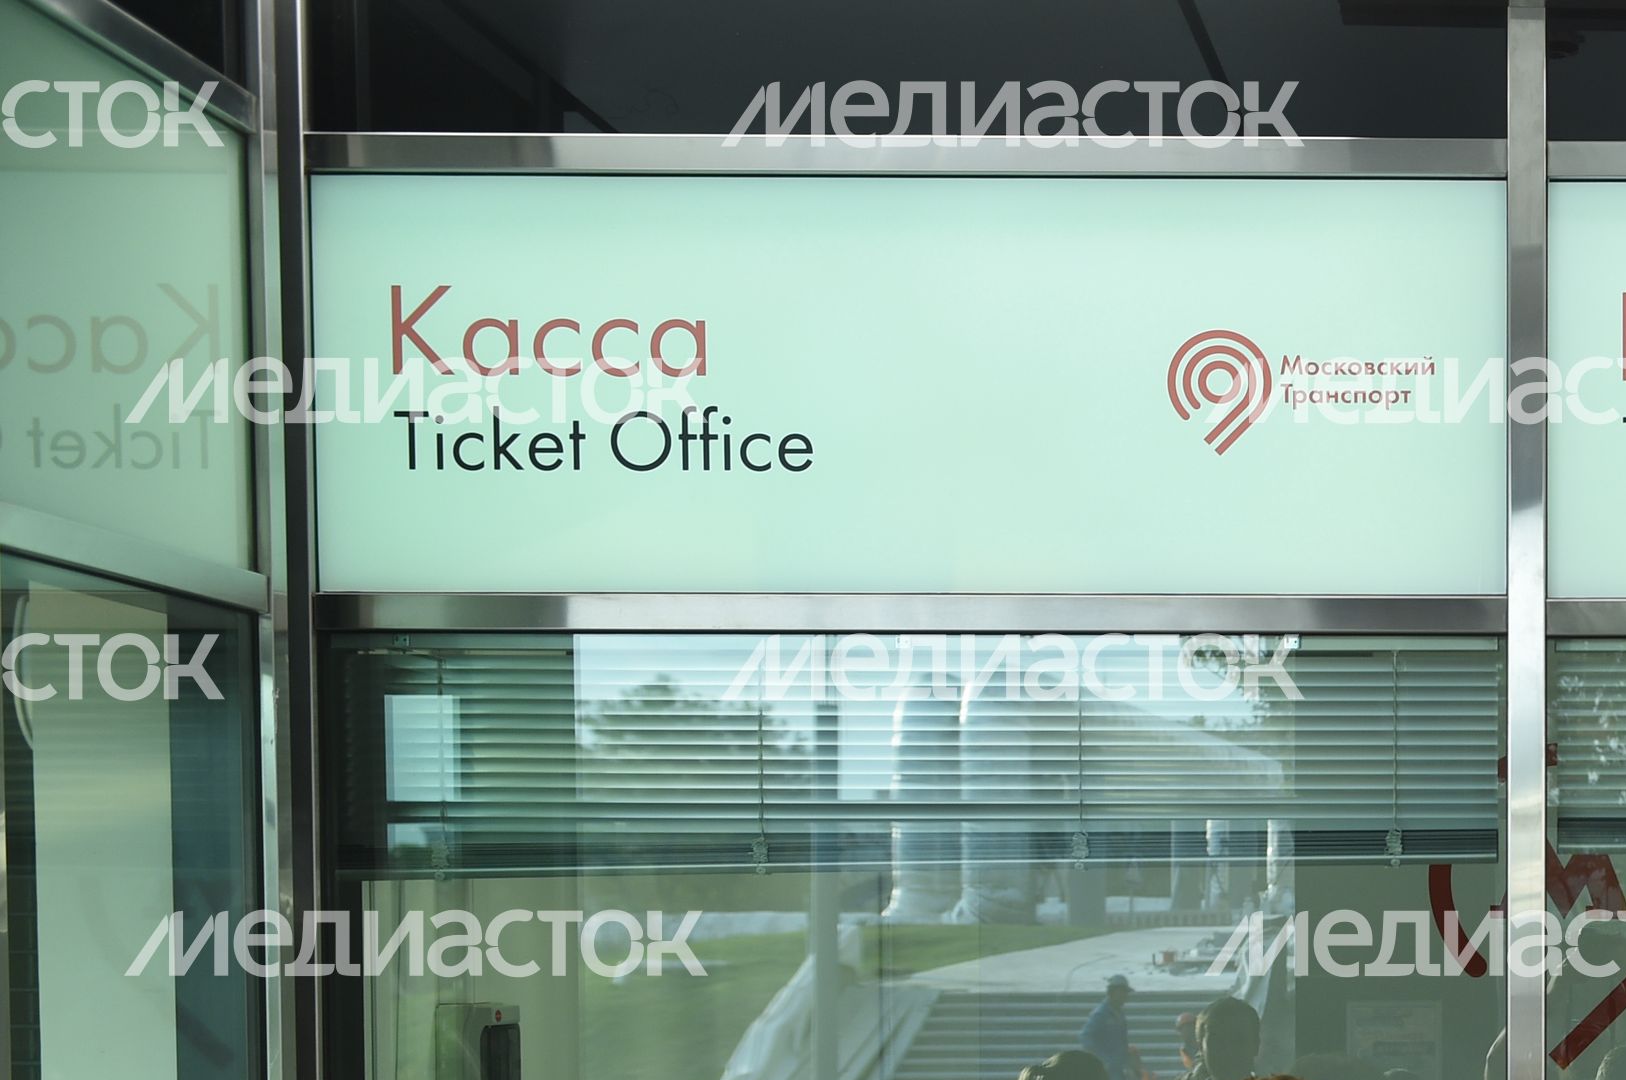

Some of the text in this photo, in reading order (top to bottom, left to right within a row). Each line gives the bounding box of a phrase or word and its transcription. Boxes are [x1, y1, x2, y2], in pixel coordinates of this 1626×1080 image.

[390, 284, 708, 379] Касса
[1280, 355, 1436, 376] Московский
[1280, 383, 1412, 411] Транспорт
[394, 405, 815, 473] Ticket Office
